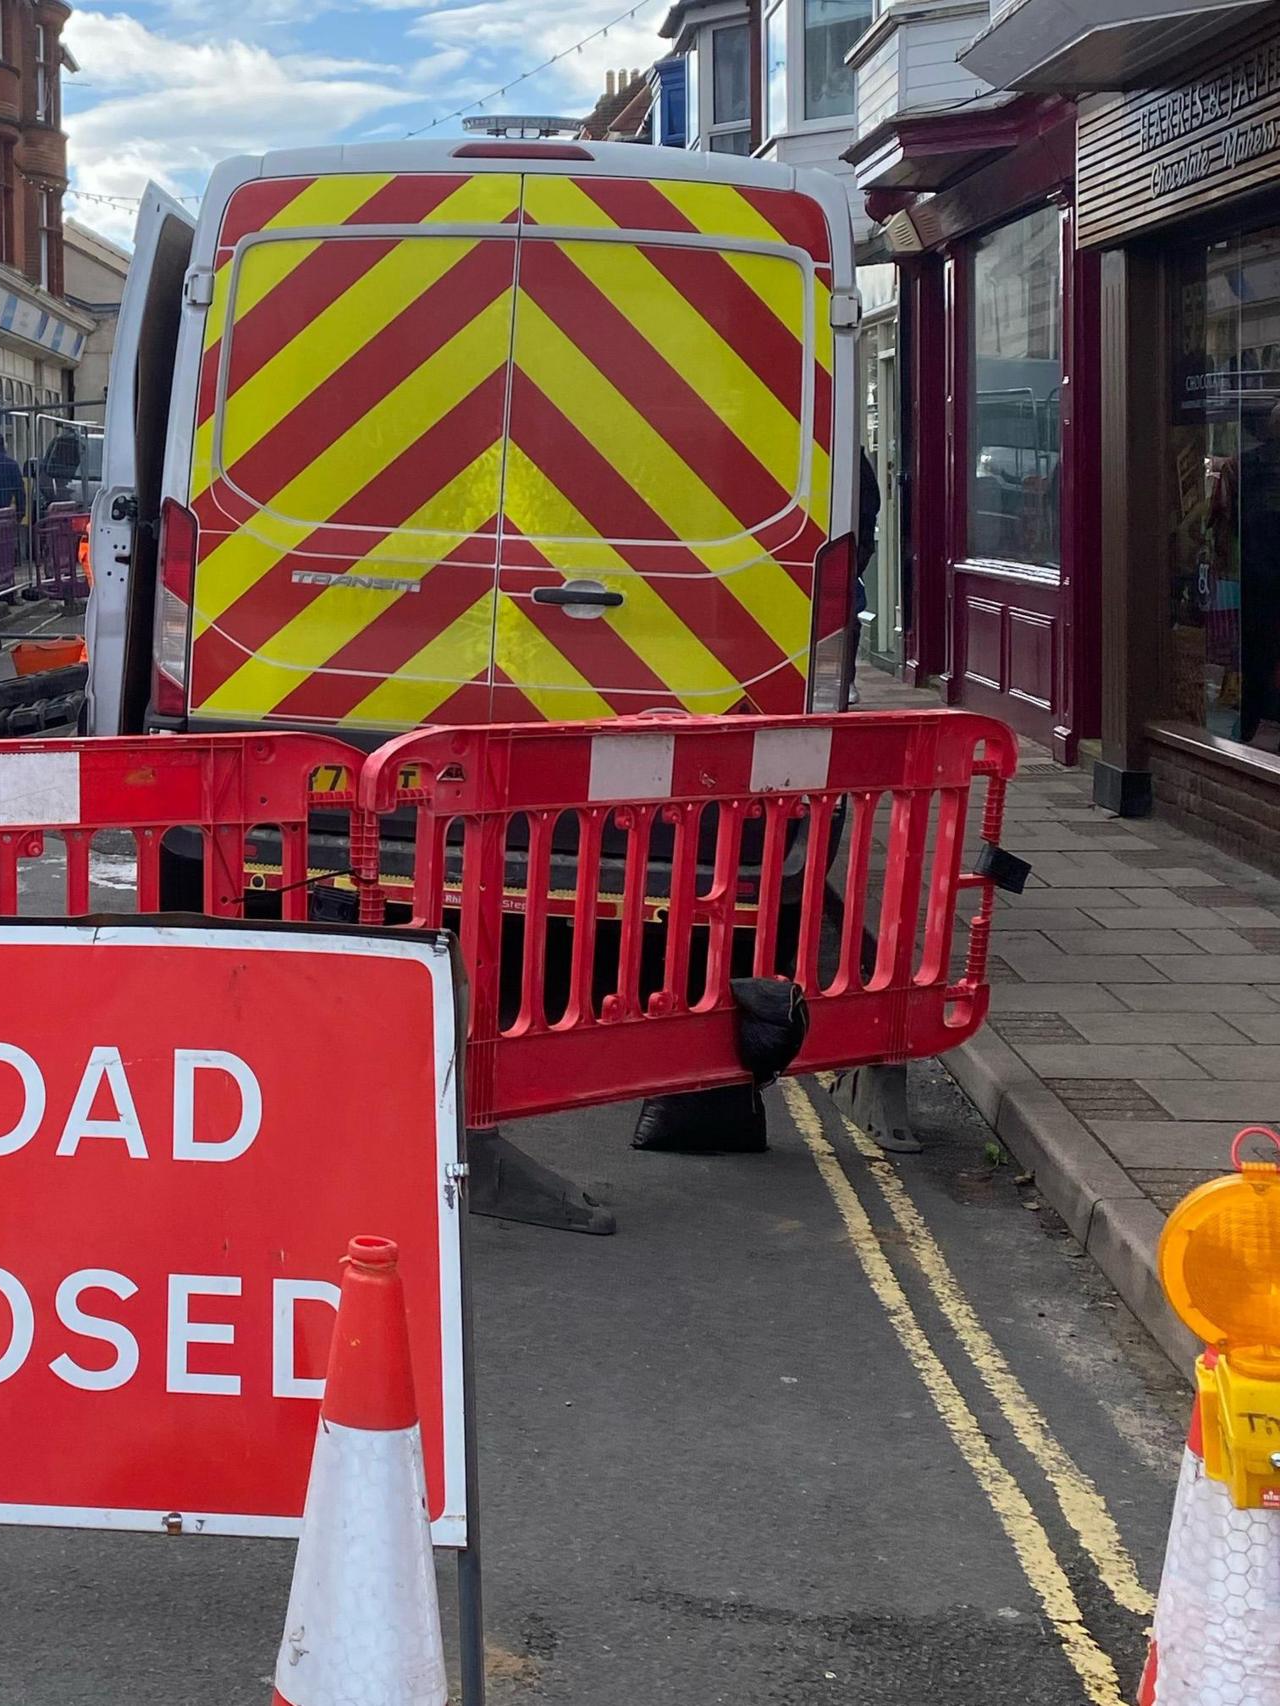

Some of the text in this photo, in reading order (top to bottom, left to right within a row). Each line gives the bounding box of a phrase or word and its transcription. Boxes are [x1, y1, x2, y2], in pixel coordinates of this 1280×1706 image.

[1140, 83, 1204, 152] HARRIS
[1208, 80, 1222, 117] &
[1151, 121, 1278, 198] Chocolate Makers
[292, 571, 421, 592] TRANSIT
